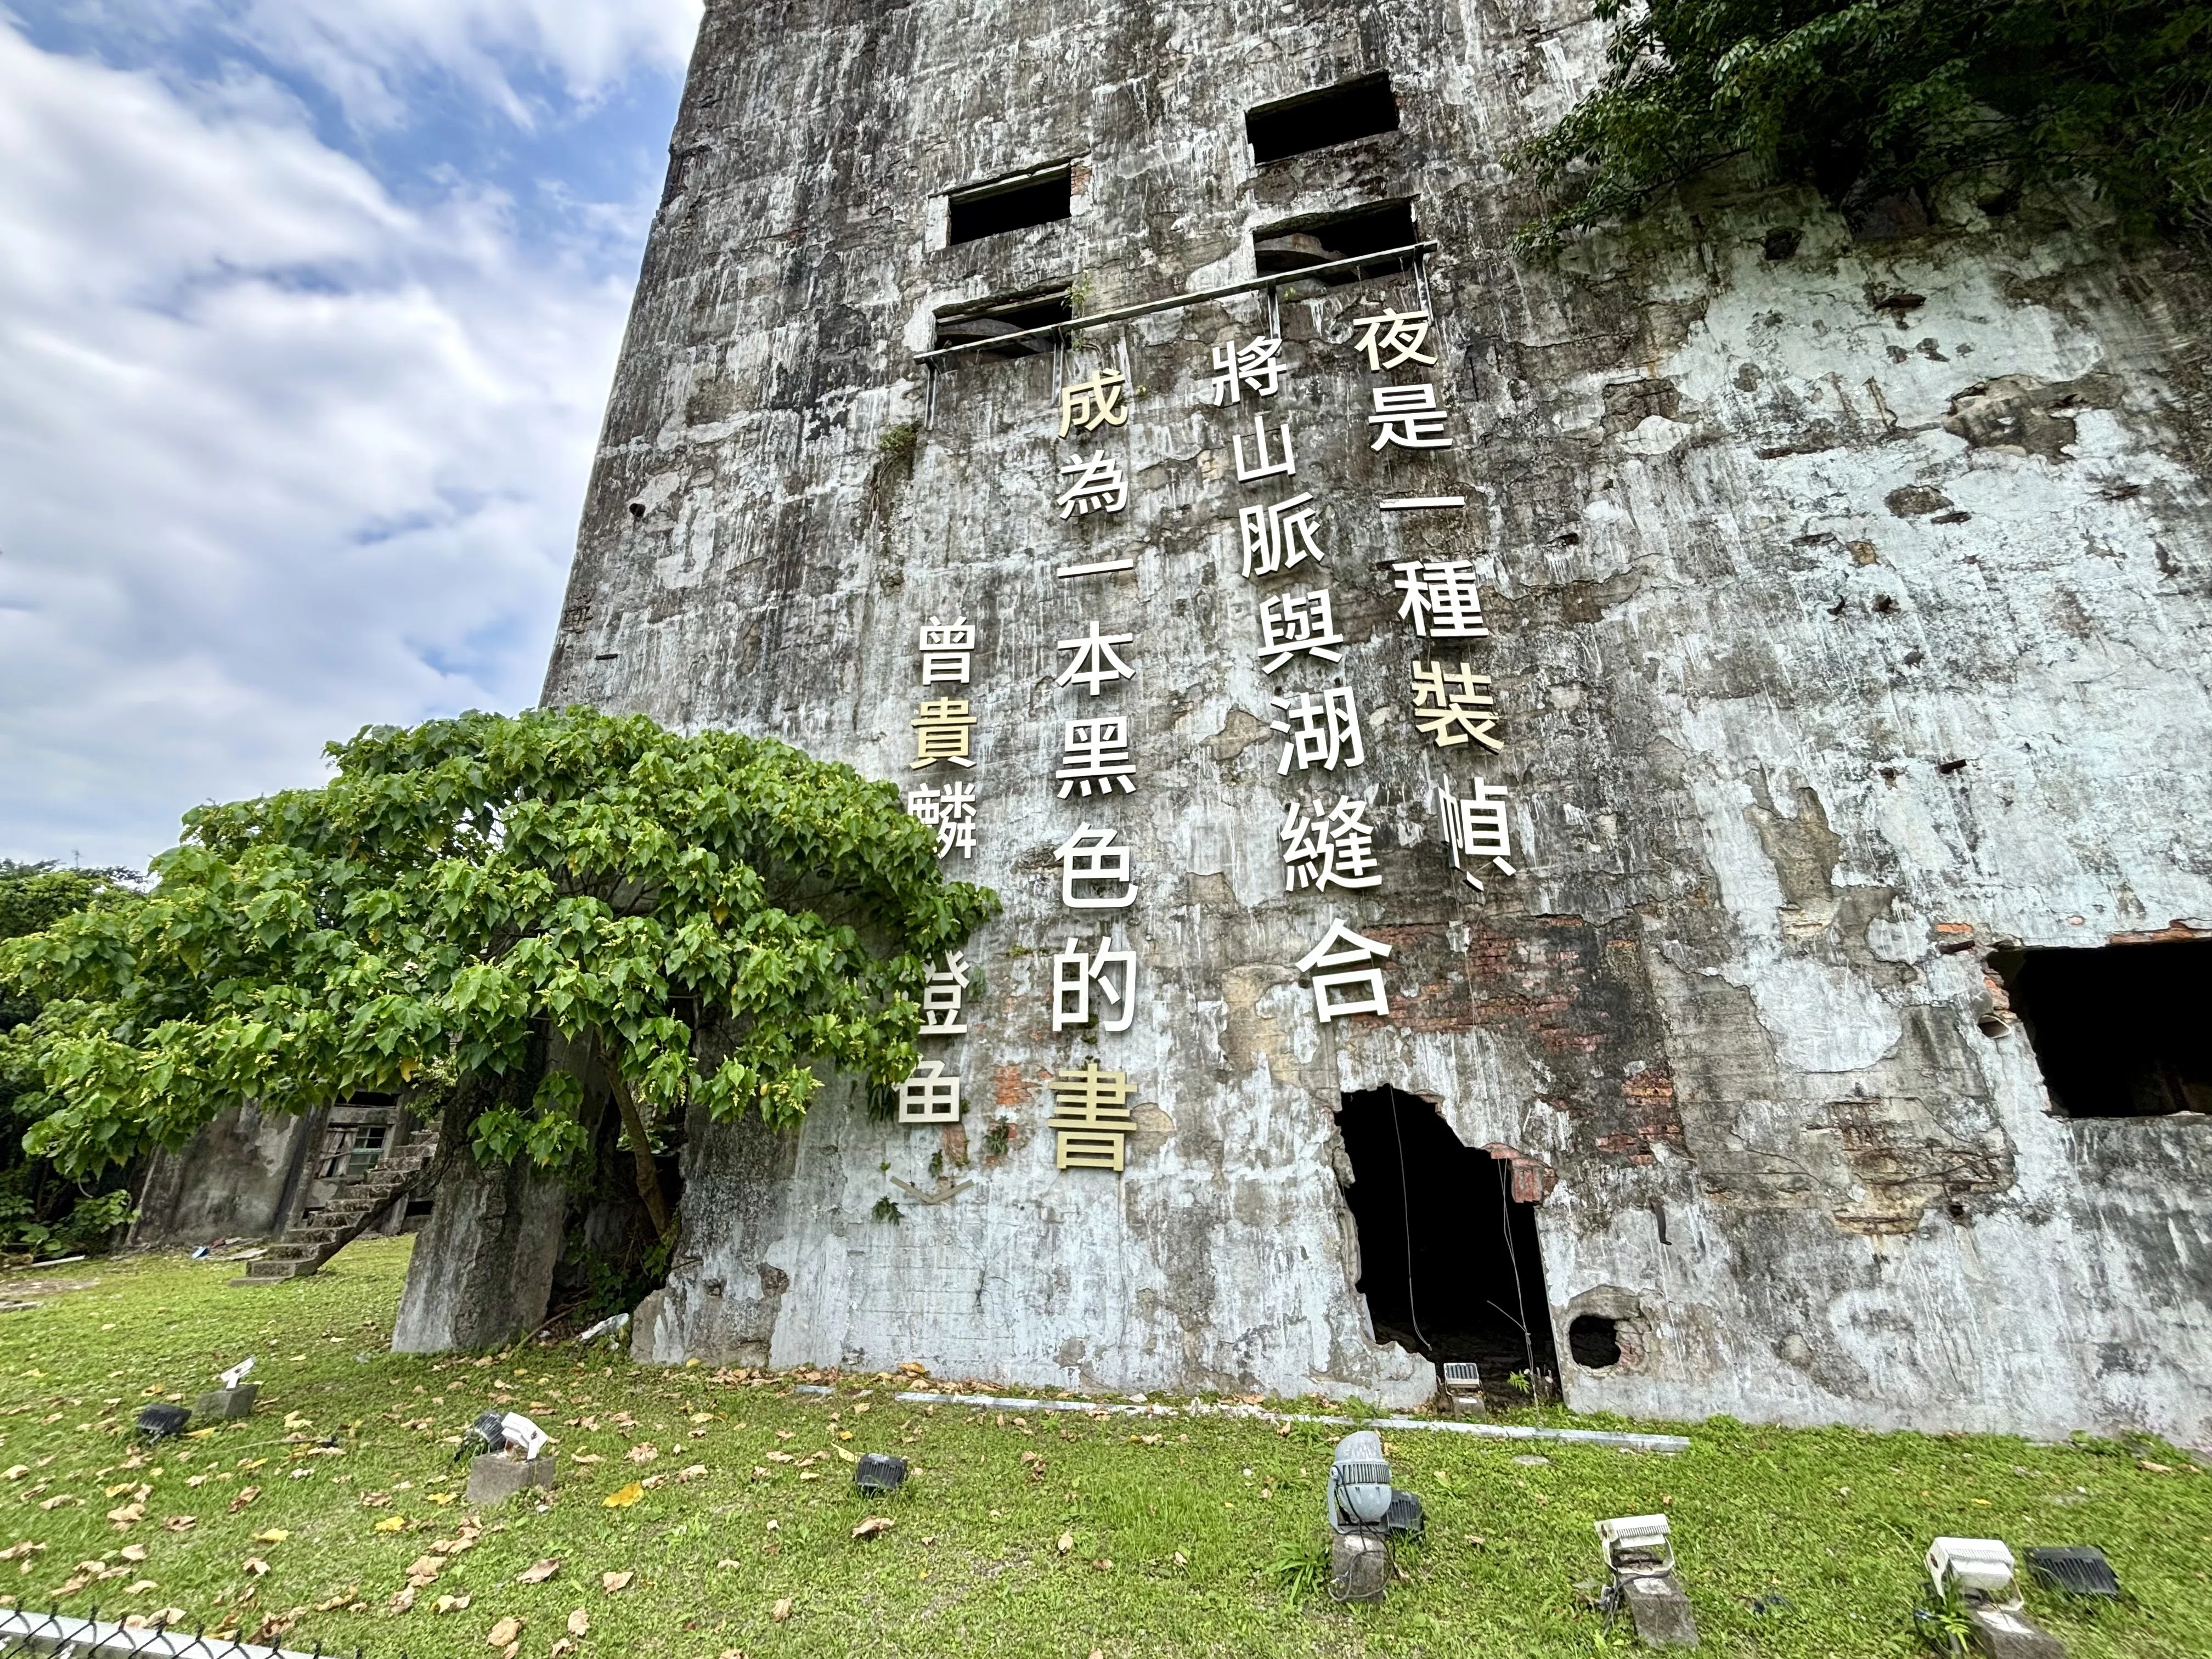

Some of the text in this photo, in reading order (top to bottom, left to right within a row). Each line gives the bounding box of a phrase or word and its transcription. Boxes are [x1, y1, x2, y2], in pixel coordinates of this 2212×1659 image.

[1047, 368, 1138, 1172] 成為一本黑色的書
[1211, 335, 1392, 1023] 將山脈與湖縫合
[1353, 307, 1516, 891] 夜是一種裝幀
